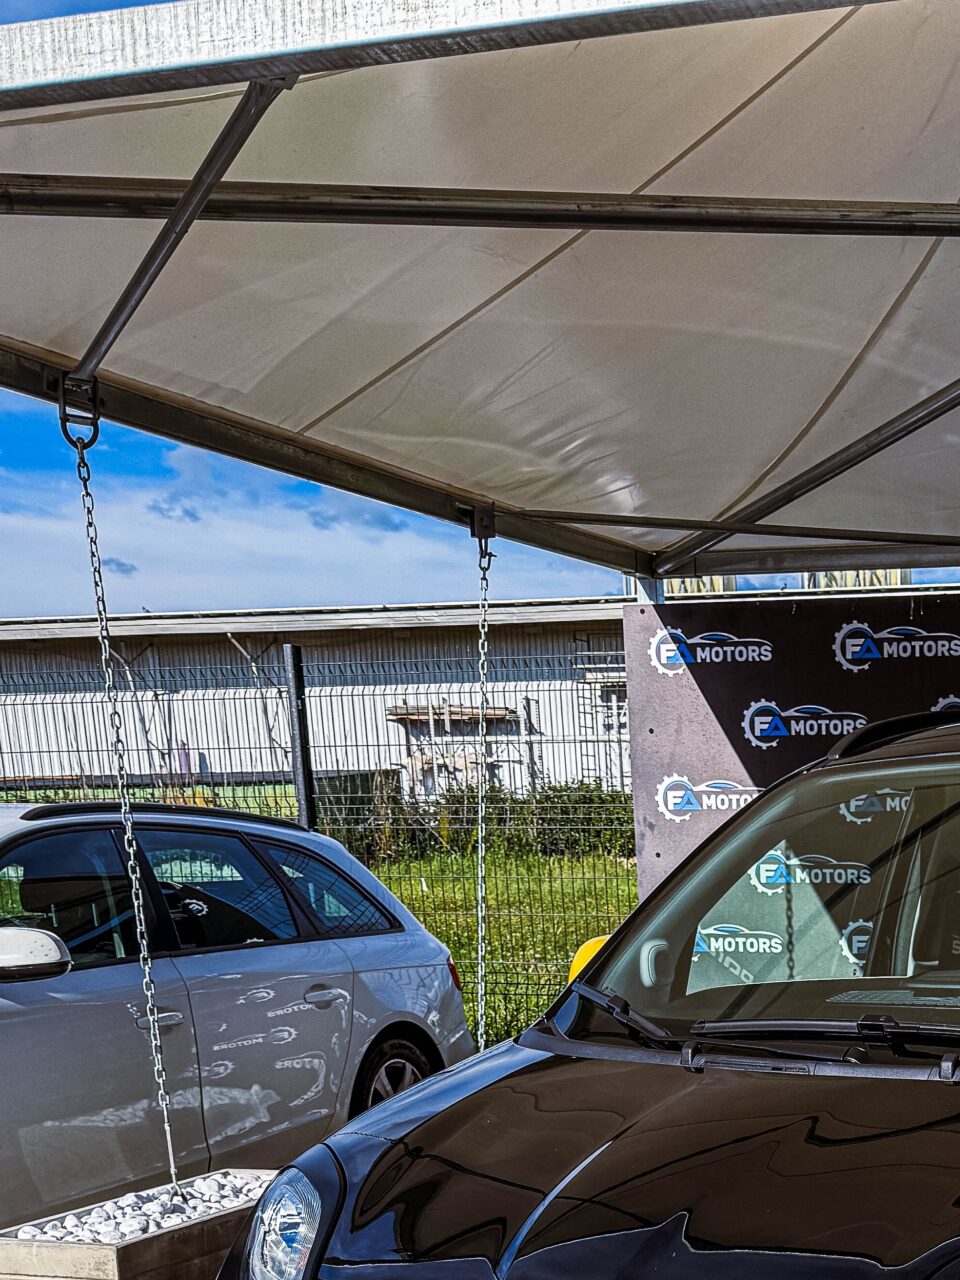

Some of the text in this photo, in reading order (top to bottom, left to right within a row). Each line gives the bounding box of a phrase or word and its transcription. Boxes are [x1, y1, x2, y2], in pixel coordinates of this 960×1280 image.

[660, 643, 773, 663] FA MOTORS
[845, 638, 882, 659] FA
[754, 716, 790, 736] FA
[667, 790, 761, 811] FA MOTO
[760, 863, 872, 884] FA MOTORS
[710, 937, 783, 953] MOTORS
